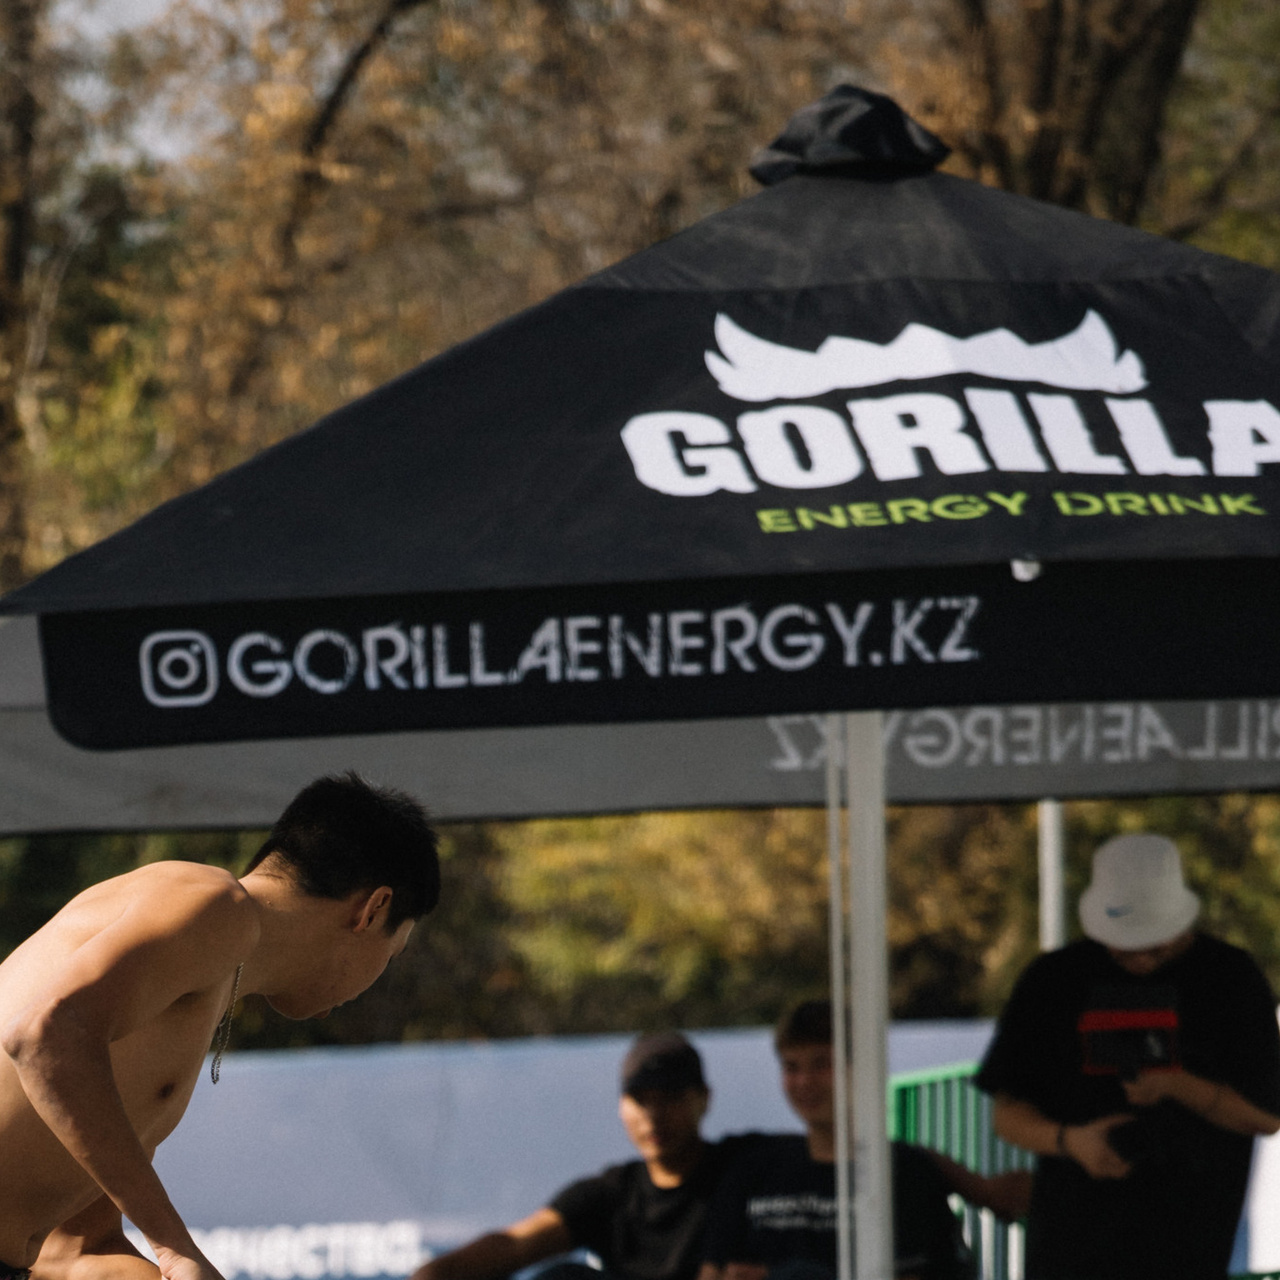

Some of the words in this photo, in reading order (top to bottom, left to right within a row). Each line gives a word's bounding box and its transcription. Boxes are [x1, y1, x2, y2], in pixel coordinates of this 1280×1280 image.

[621, 388, 1280, 497] GORILLA
[756, 491, 1028, 533] ENERGY
[1052, 491, 1268, 517] DRINK
[227, 596, 980, 698] GORILLAENERGY.KZ
